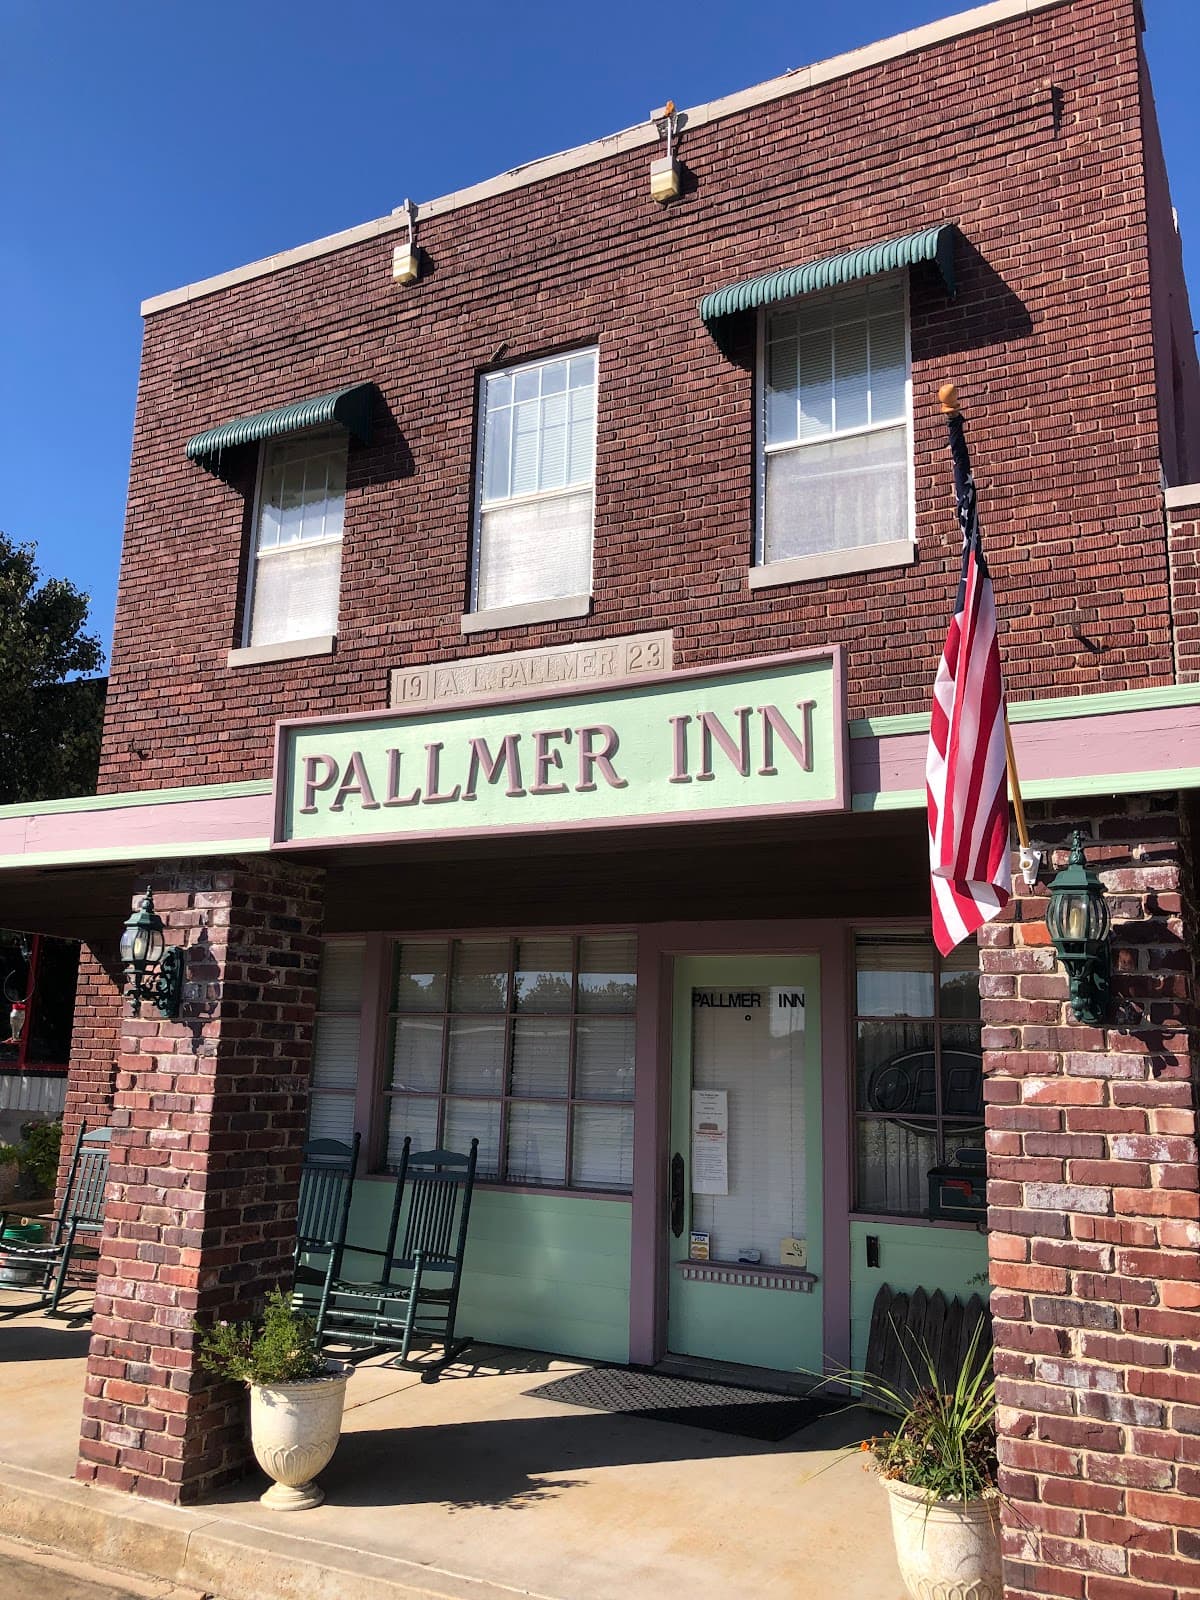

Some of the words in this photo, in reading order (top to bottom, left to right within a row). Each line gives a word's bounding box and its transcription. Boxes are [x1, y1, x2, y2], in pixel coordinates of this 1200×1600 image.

[402, 675, 422, 698] 19
[498, 651, 614, 688] PALLMER
[629, 643, 660, 670] 23
[299, 724, 630, 815] PALLMER
[669, 699, 818, 784] INN
[692, 993, 760, 1007] PALLMER
[779, 993, 804, 1007] INN
